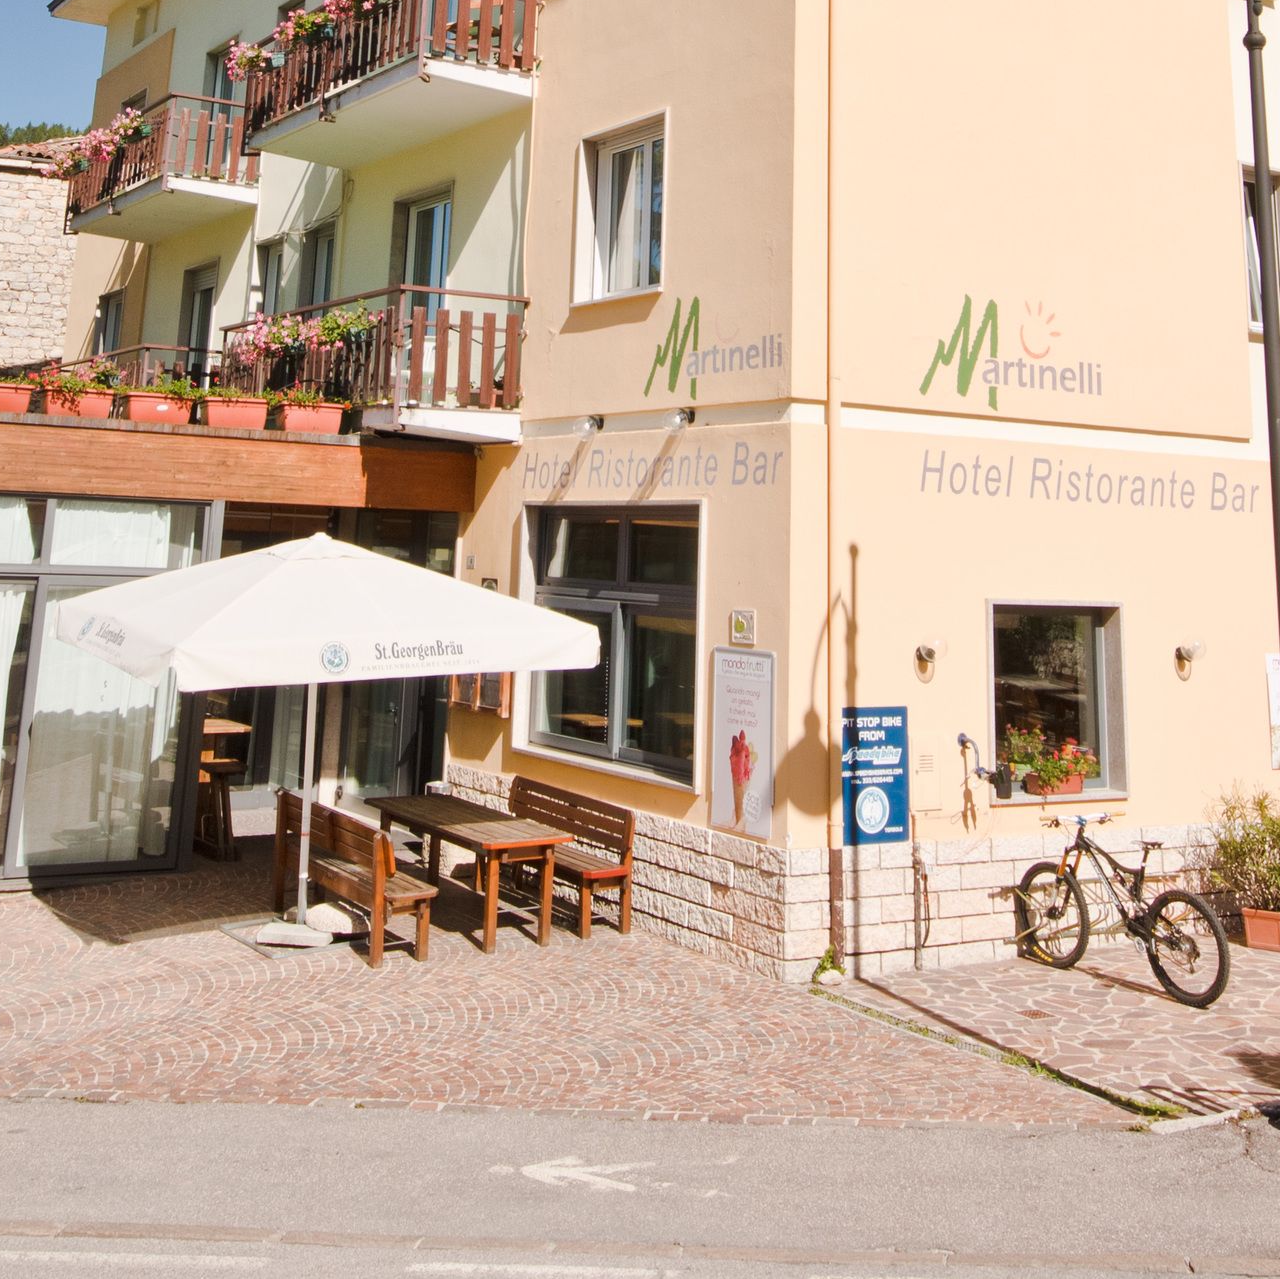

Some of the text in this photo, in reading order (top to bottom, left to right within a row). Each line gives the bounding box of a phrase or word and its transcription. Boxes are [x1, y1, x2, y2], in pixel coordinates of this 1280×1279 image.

[643, 296, 783, 401] Martinelli
[919, 293, 1102, 412] Martinelli
[521, 441, 784, 489] Hotel Ristorante Bar
[920, 448, 1260, 513] Hotel Ristorante Bar
[842, 716, 902, 728] PIT STOP BIKE
[859, 730, 885, 741] FROM
